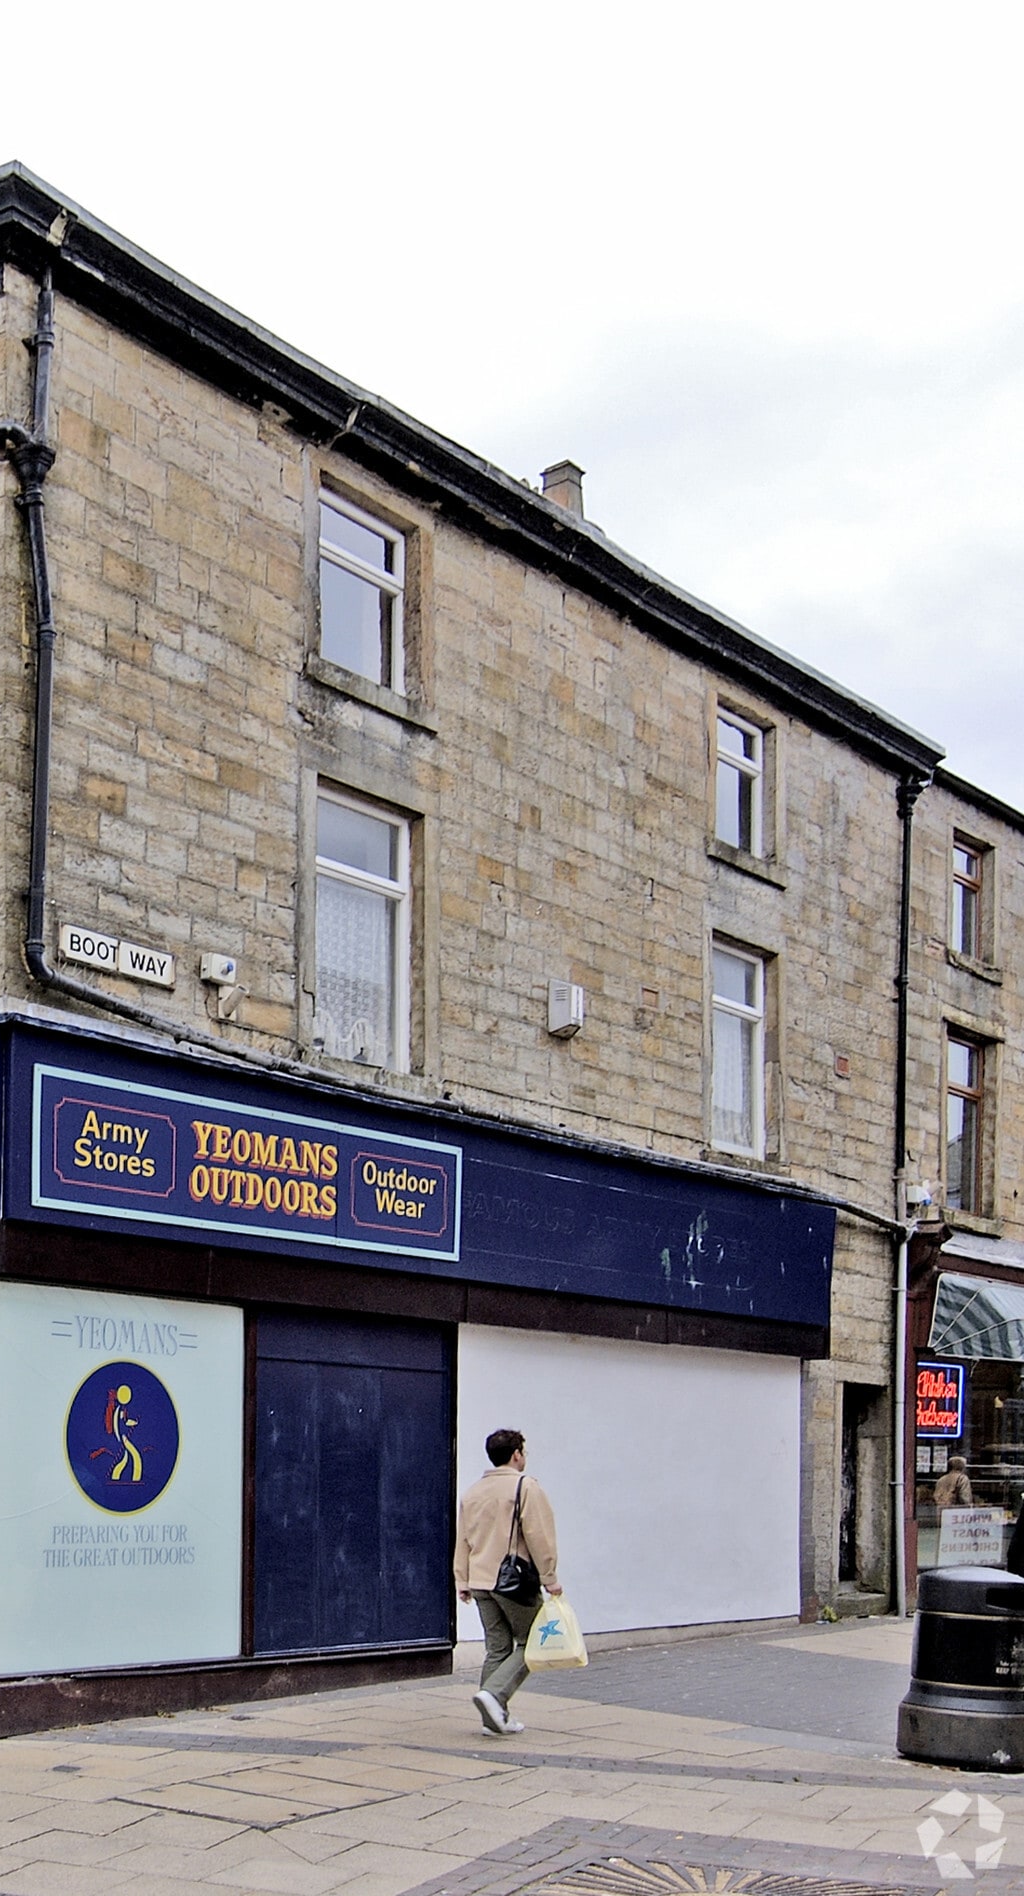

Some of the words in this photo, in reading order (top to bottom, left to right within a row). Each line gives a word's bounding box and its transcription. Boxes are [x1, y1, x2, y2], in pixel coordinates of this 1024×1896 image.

[70, 933, 117, 962] BOOT
[130, 951, 166, 976] WAY
[81, 1110, 149, 1154] Army
[191, 1120, 339, 1179] YEOMANS
[74, 1137, 156, 1177] Stores
[362, 1160, 437, 1195] Outdoor
[189, 1164, 338, 1220] OUTDOORS
[375, 1187, 426, 1219] Wear
[75, 1315, 178, 1357] YEOMANS
[52, 1525, 128, 1544] PREPARING
[133, 1524, 159, 1543] YOU
[162, 1524, 188, 1543] FOR
[43, 1549, 70, 1568] THE
[73, 1548, 119, 1568] GREAT
[121, 1546, 195, 1566] OUTDOORS
